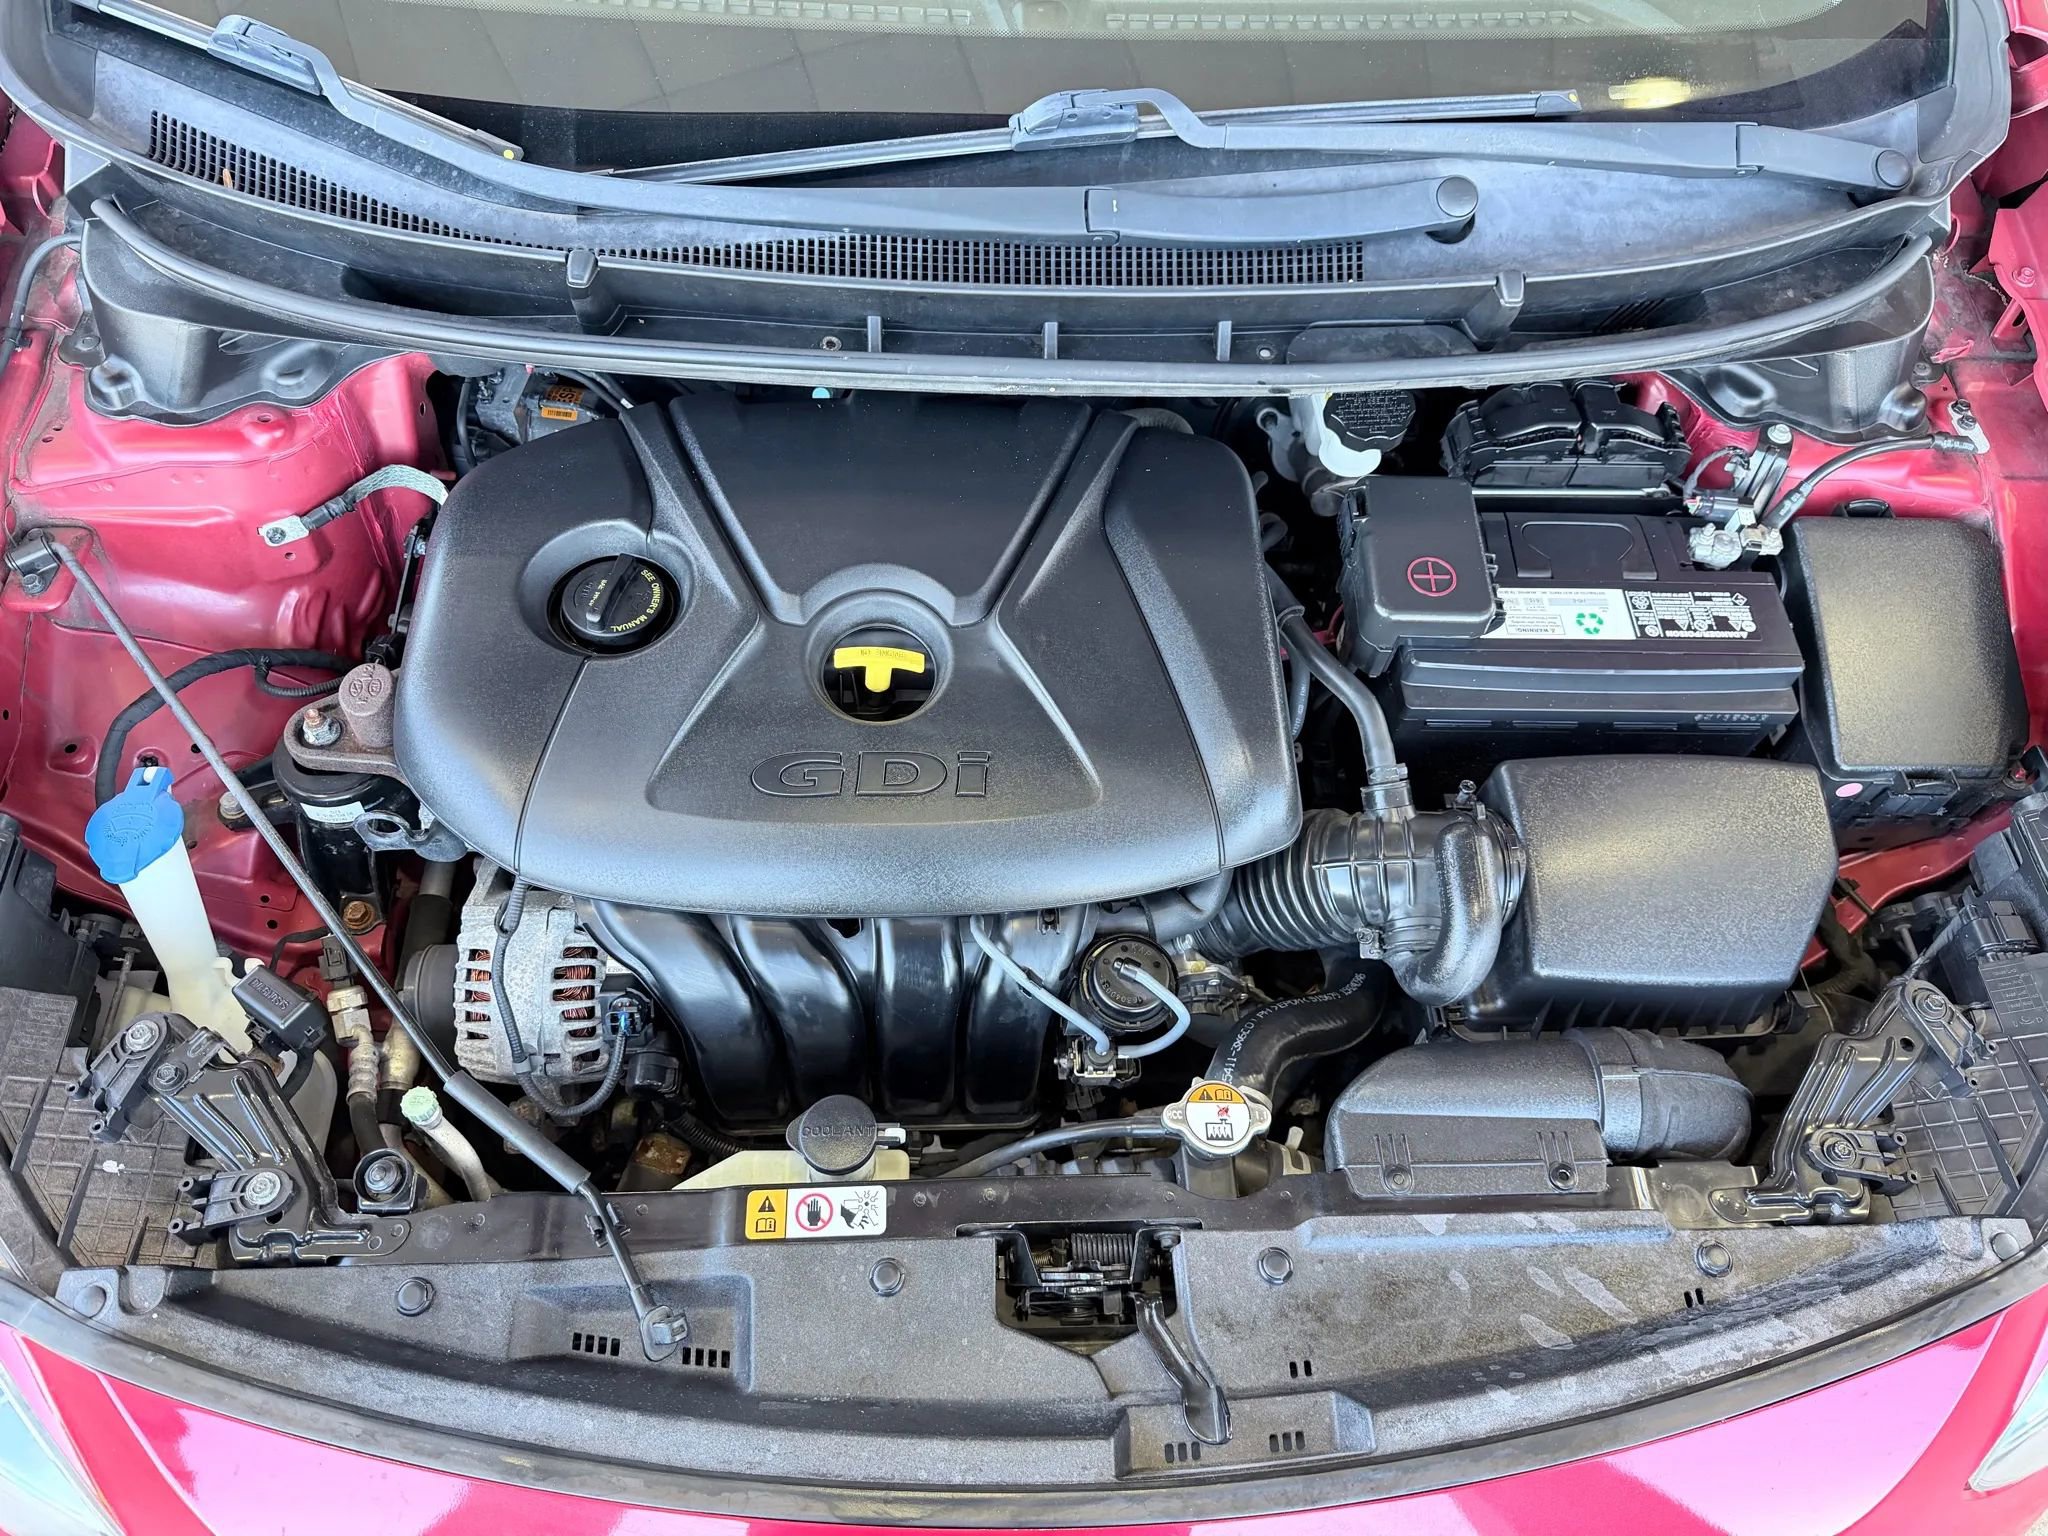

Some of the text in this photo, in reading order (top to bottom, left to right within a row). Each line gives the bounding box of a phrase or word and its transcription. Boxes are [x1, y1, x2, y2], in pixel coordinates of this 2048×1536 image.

[611, 569, 661, 632] SEE OWNER'S MANUAL
[751, 750, 991, 798] GDi
[801, 1124, 875, 1138] COOLANT
